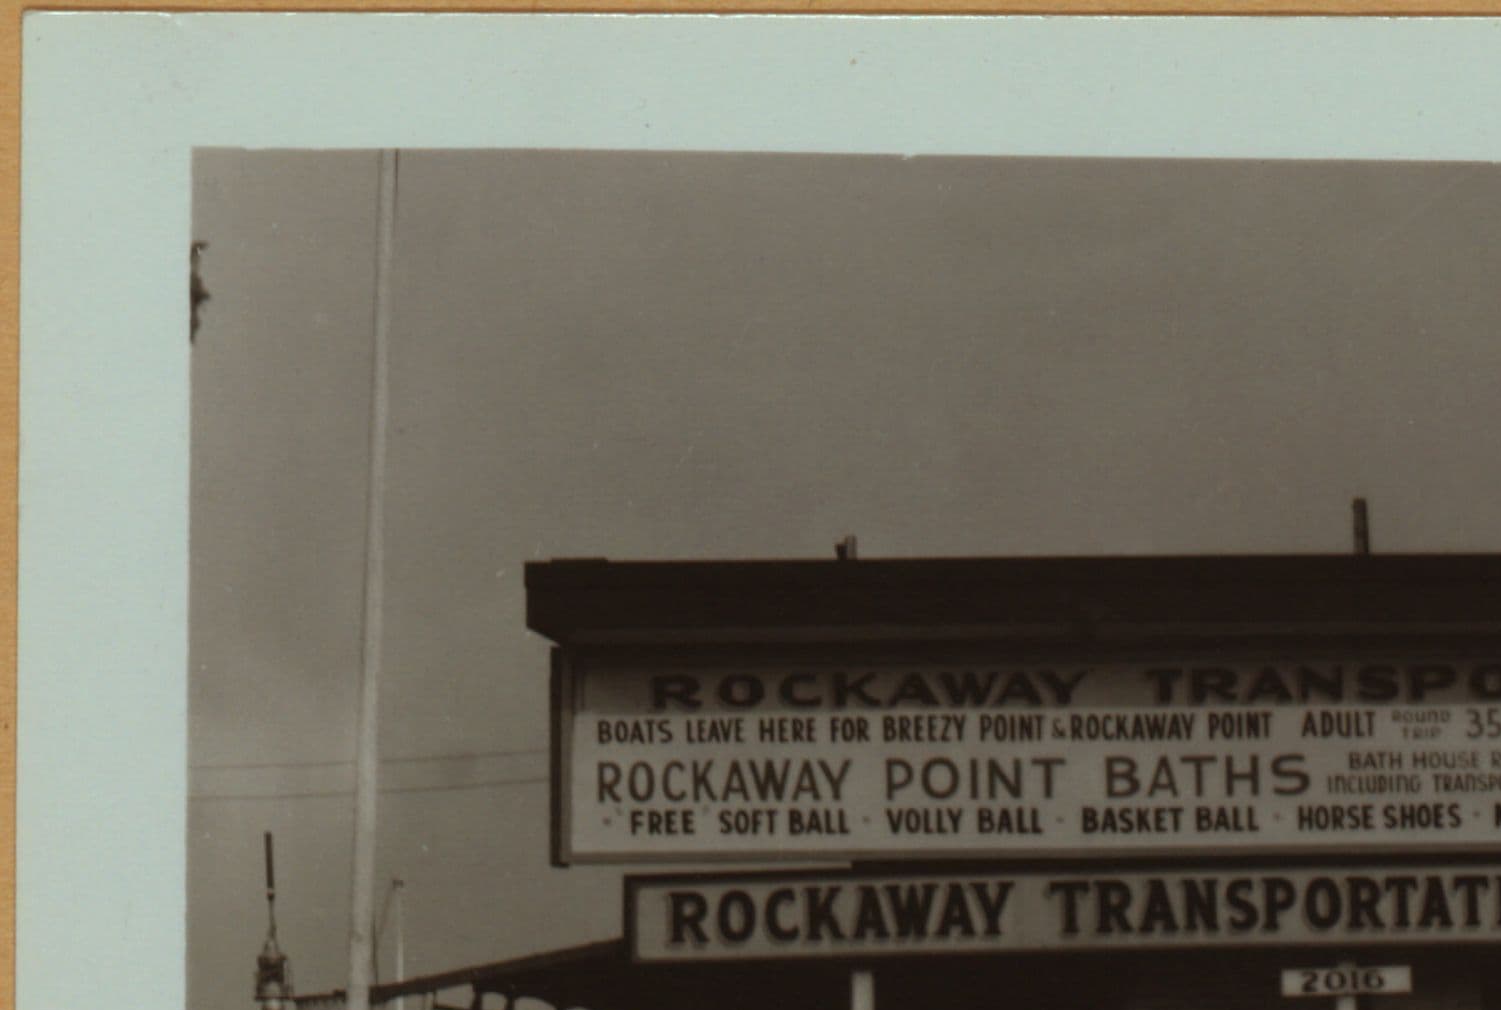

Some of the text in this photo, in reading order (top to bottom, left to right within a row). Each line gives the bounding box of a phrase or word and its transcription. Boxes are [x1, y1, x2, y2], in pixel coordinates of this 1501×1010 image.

[652, 672, 1087, 710] ROCKAWAY
[597, 711, 1376, 745] BOATS LEAVE HERE FOR BREEZY POINT & ROCKAWAY POINT ADULT
[1402, 726, 1442, 739] TRIP
[1348, 751, 1402, 771] BATH
[1413, 750, 1480, 770] HOUSE
[597, 754, 1311, 803] ROCKAWAY POINT BATHS
[630, 809, 695, 836] FREE
[719, 809, 778, 836] SOFT
[788, 809, 850, 836] BALL
[886, 807, 963, 835] VOLLY
[977, 807, 1043, 835] BALL
[1081, 806, 1185, 834] BASKET
[1195, 805, 1260, 833] BALL
[1298, 804, 1374, 832] HORSE
[1383, 803, 1461, 830] SHOES
[665, 881, 1015, 948] ROCKAWAY
[1301, 968, 1386, 993] 2016
